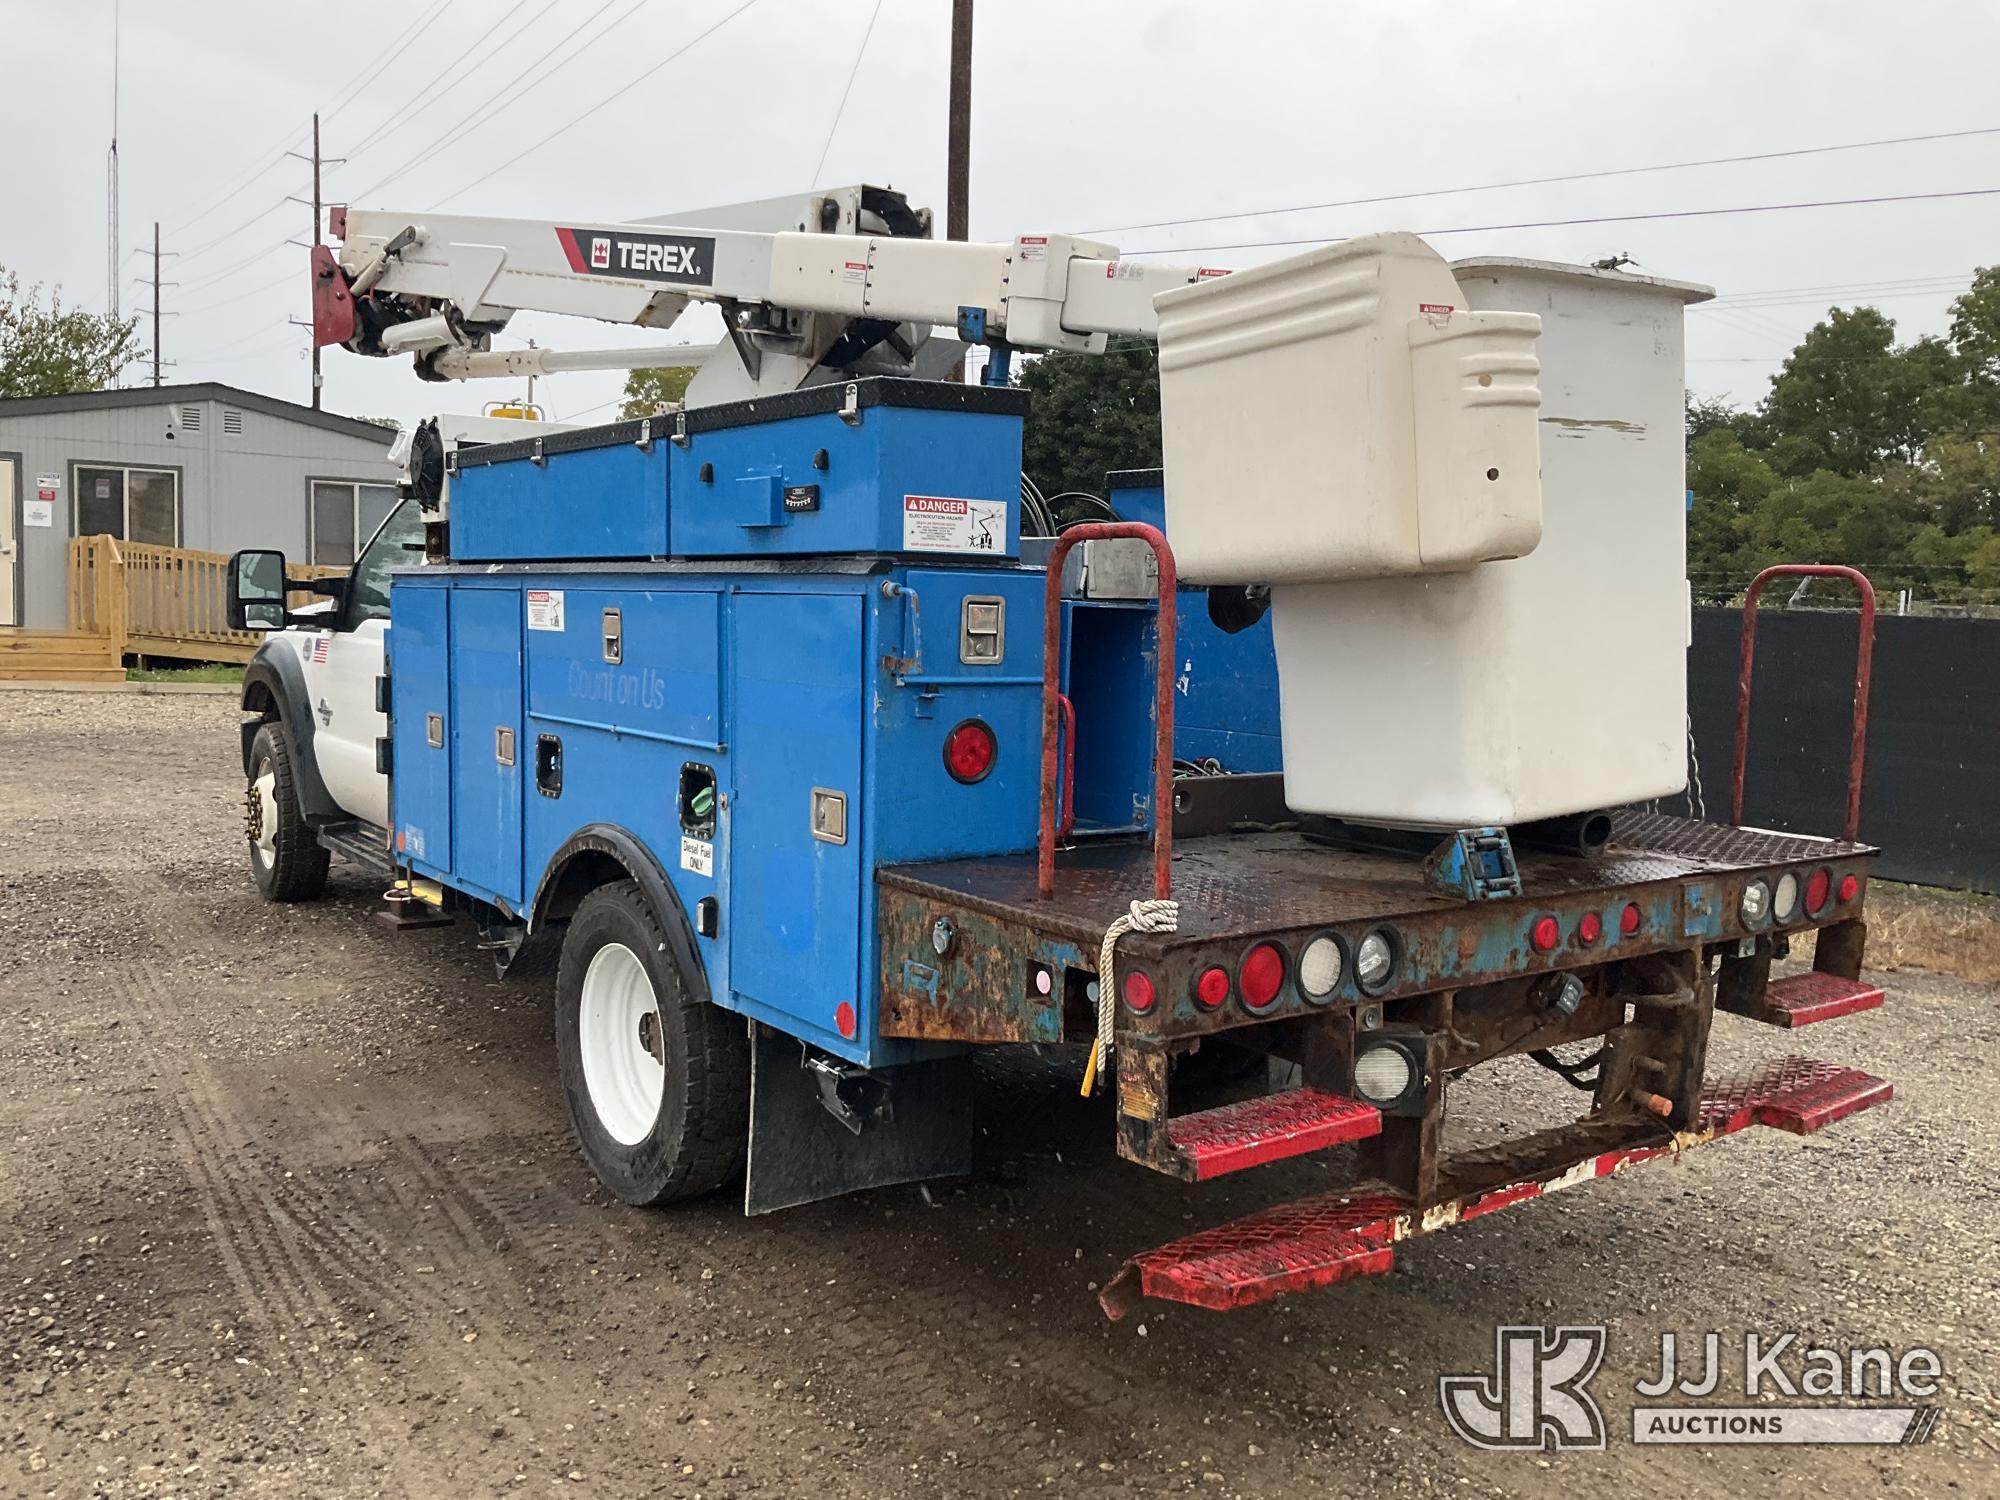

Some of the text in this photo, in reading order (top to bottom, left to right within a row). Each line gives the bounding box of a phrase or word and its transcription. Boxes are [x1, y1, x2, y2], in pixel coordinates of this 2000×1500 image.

[920, 500, 964, 513] DANGER
[568, 660, 665, 710] Count on Us
[683, 840, 712, 858] Diesel Fuel
[690, 856, 703, 870] ONLY
